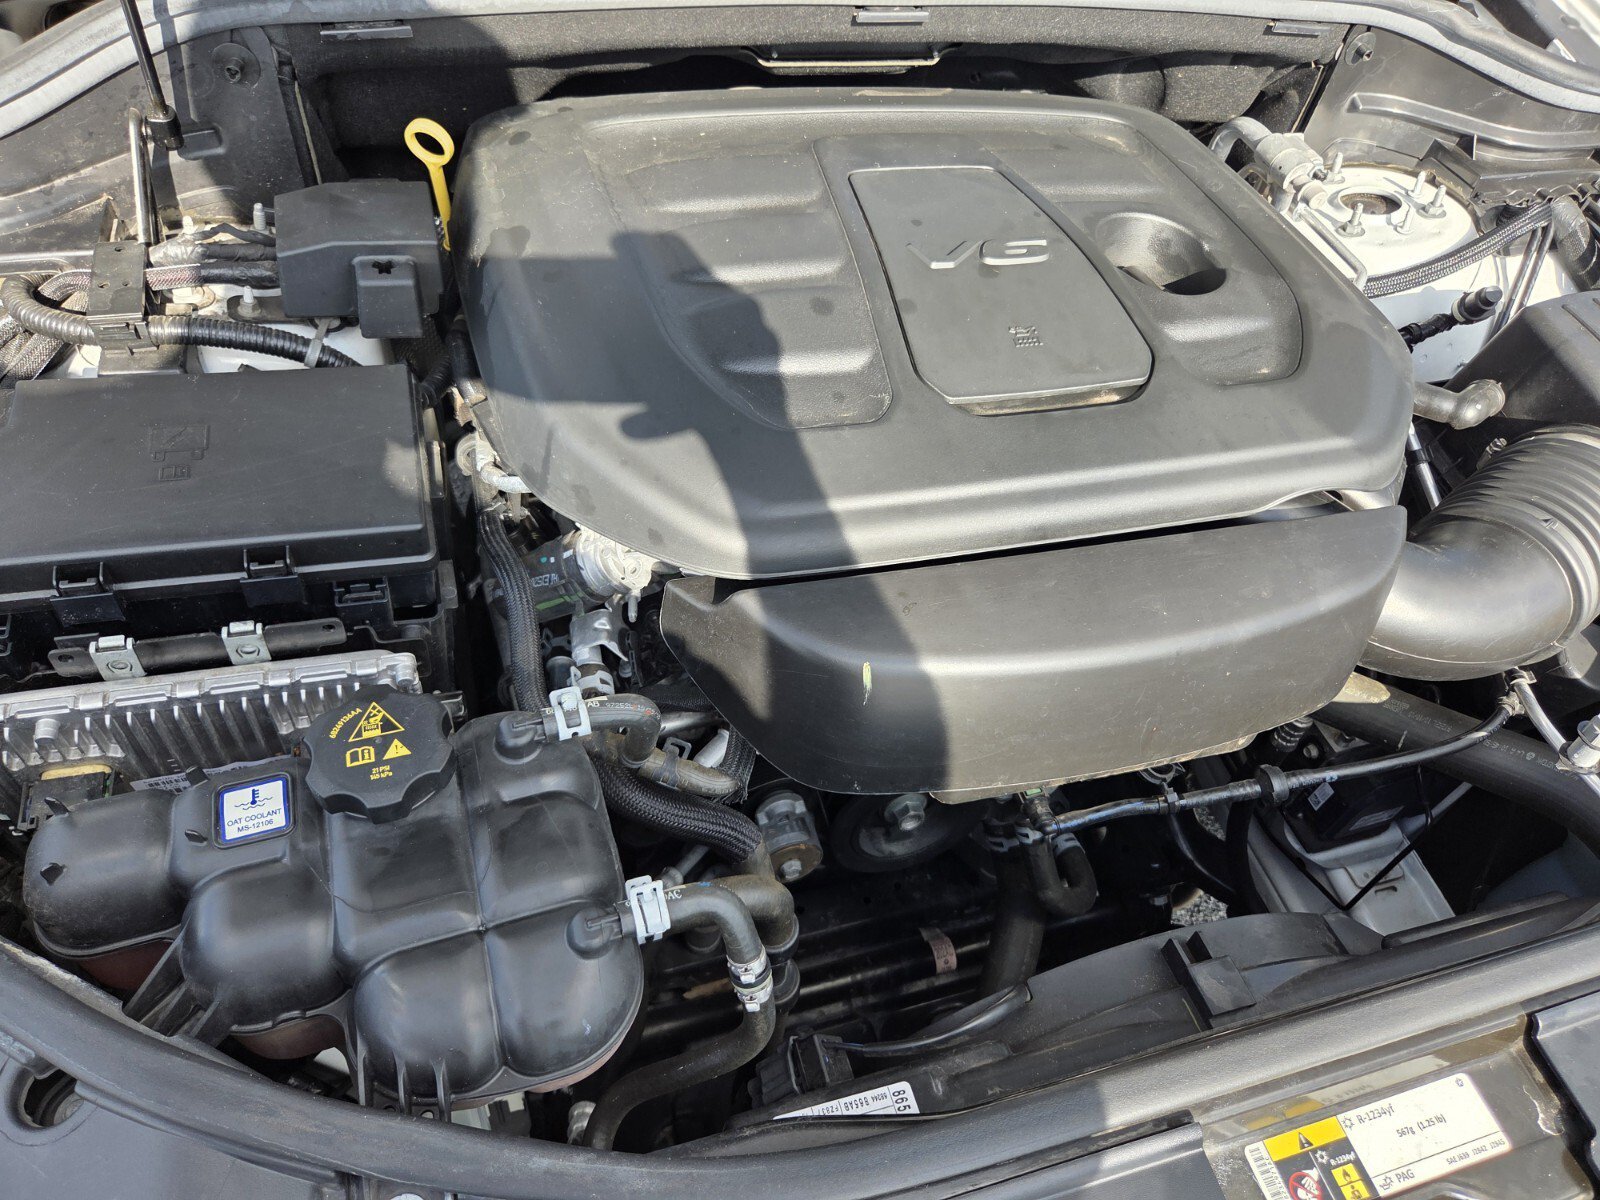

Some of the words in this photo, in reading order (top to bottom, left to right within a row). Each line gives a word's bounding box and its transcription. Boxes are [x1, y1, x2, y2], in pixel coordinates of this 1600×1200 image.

[905, 239, 1049, 270] V6
[227, 818, 243, 827] OAT
[244, 808, 282, 822] COOLANT
[237, 819, 274, 833] MS-12106
[844, 1097, 870, 1112] 865AB
[892, 1089, 911, 1112] 865
[1356, 1103, 1395, 1124] R-1234yf
[1396, 1126, 1416, 1138] 567g
[1395, 1169, 1415, 1183] PAG
